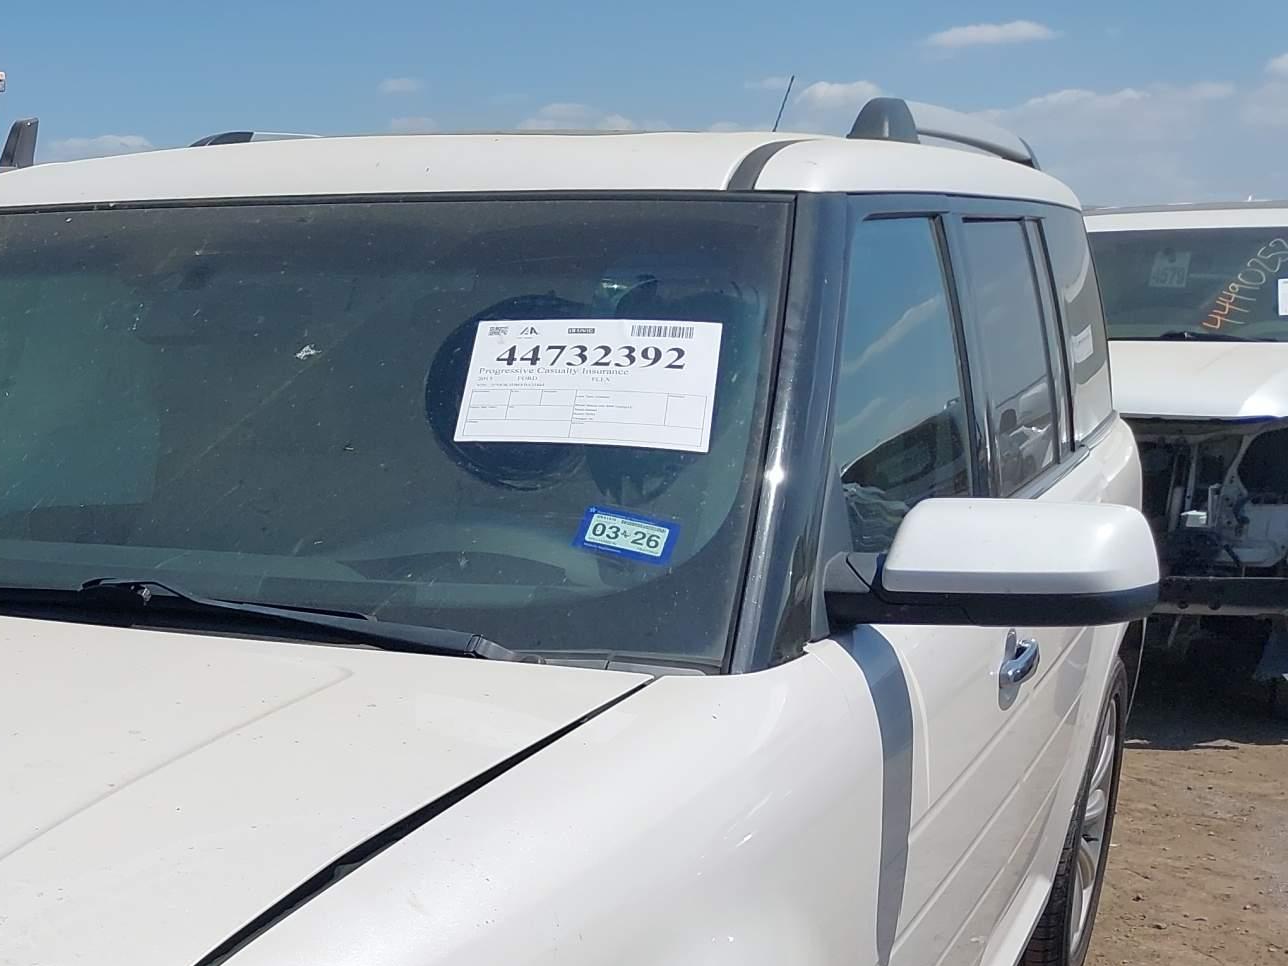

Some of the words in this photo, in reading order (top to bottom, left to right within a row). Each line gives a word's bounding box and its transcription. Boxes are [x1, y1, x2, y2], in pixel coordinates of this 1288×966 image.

[495, 344, 687, 371] 44732392
[479, 367, 535, 376] Progressive
[537, 367, 579, 376] Casualty
[582, 367, 630, 376] Insurance
[592, 522, 621, 540] 03
[630, 530, 661, 549] 26
